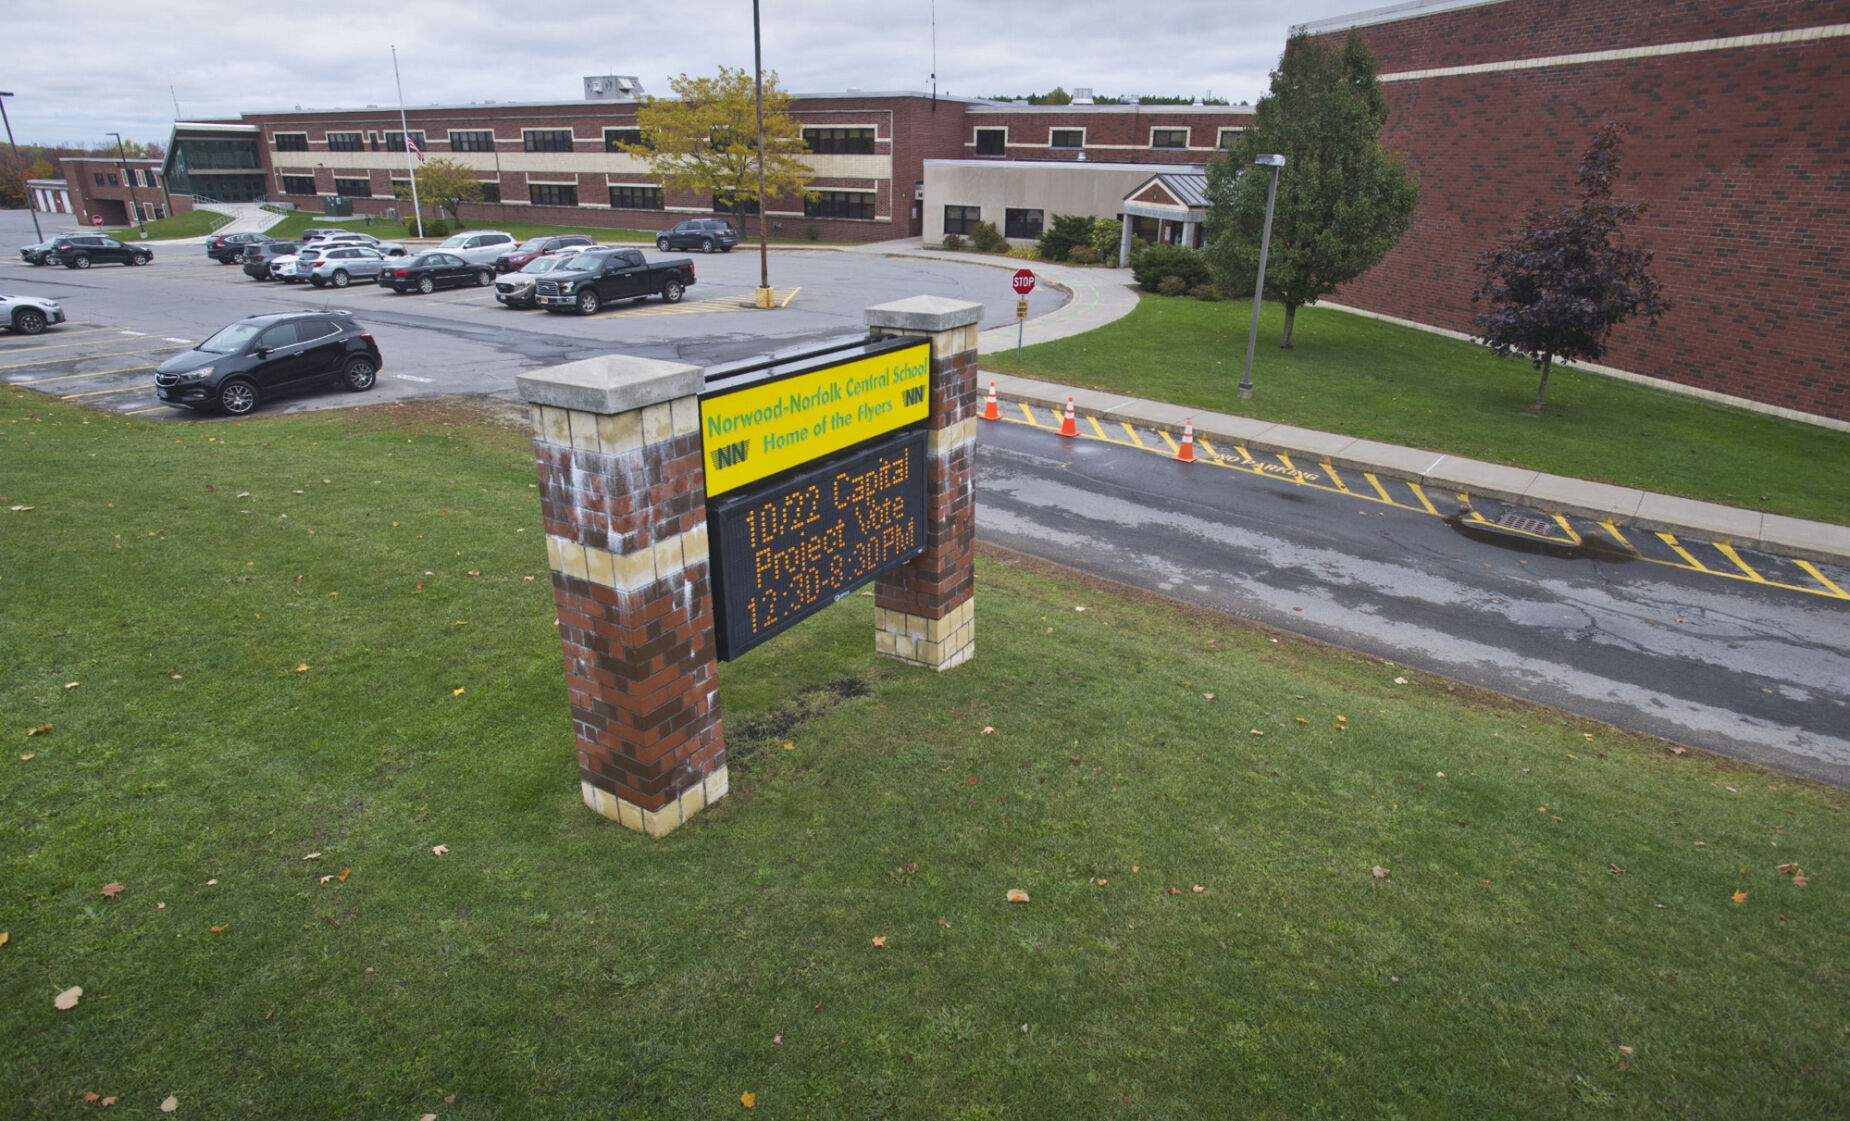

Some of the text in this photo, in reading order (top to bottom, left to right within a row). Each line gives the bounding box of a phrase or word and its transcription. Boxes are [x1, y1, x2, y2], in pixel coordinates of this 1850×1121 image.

[1013, 276, 1034, 288] STOP
[707, 356, 928, 438] Norwood-Norfolk Central School
[763, 399, 893, 453] Home of the Flyers
[714, 440, 747, 470] NN
[1215, 453, 1320, 480] NO PARKING
[746, 447, 909, 548] 10/22 Capital
[755, 496, 904, 588] Project Vote
